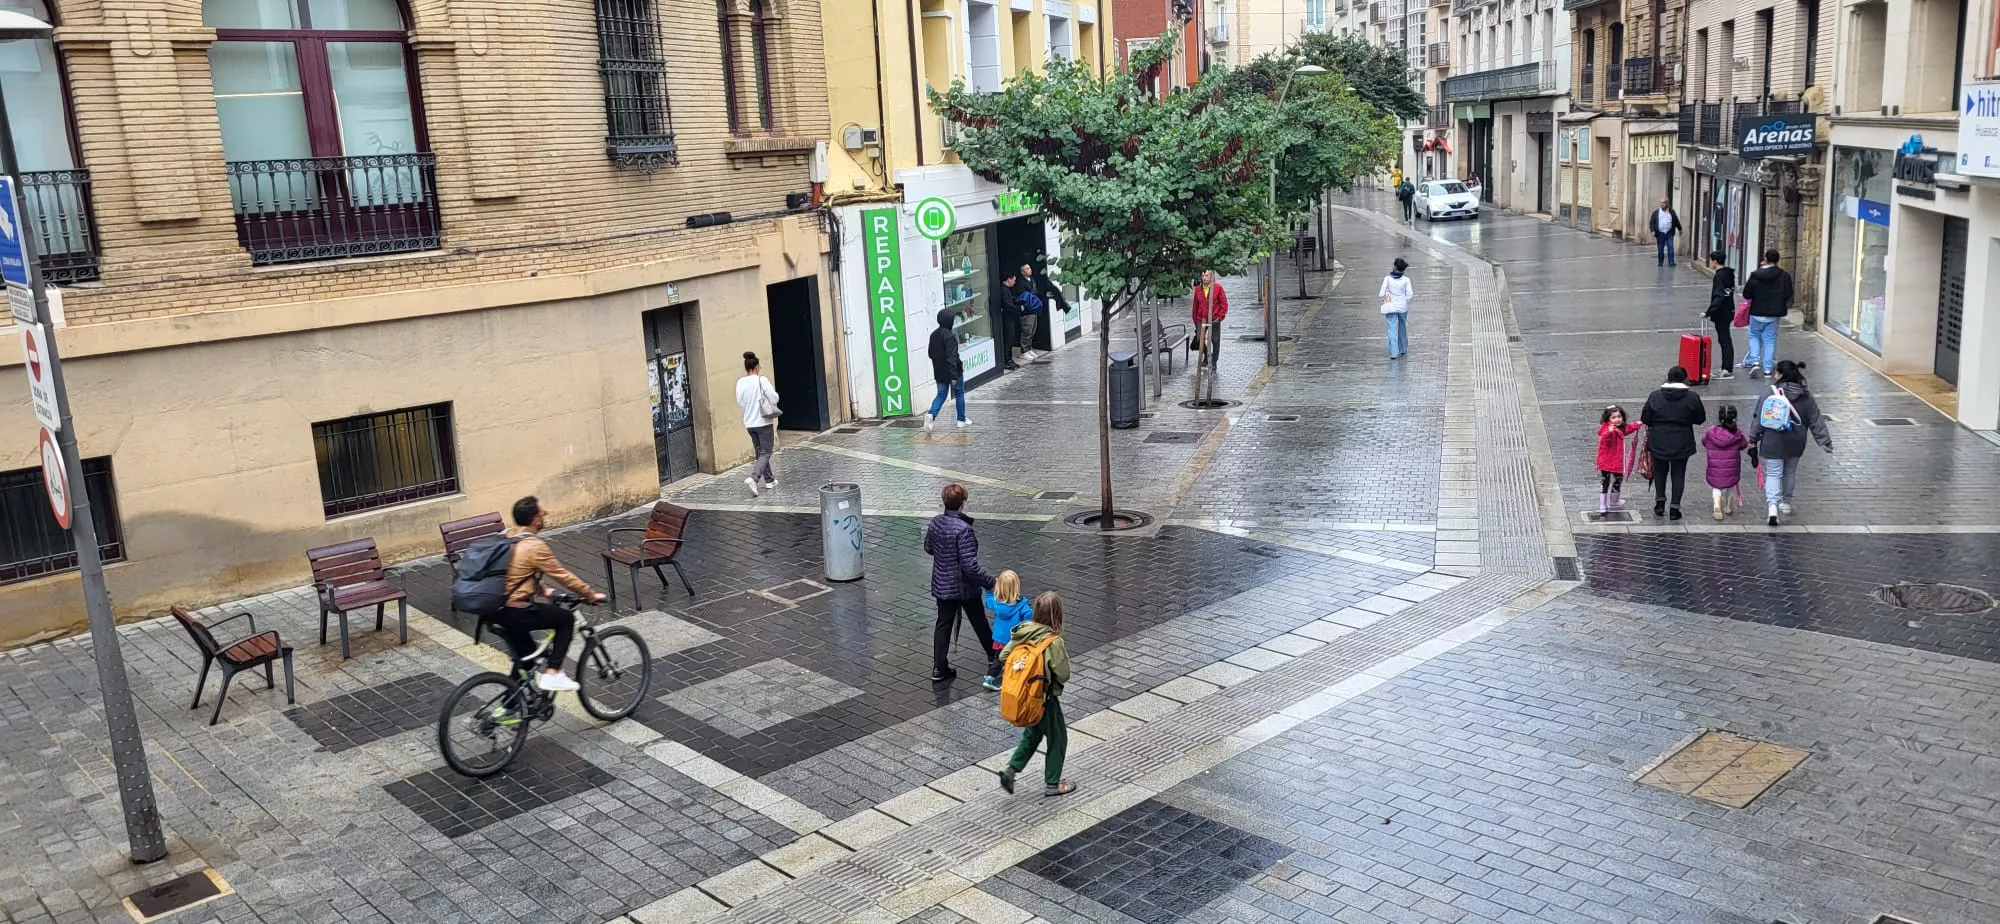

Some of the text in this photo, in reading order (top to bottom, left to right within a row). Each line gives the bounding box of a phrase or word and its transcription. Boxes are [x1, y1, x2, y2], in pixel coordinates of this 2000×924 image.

[1633, 135, 1674, 158] ASCASO
[1744, 128, 1813, 144] Arenas
[873, 216, 903, 412] REPARACION
